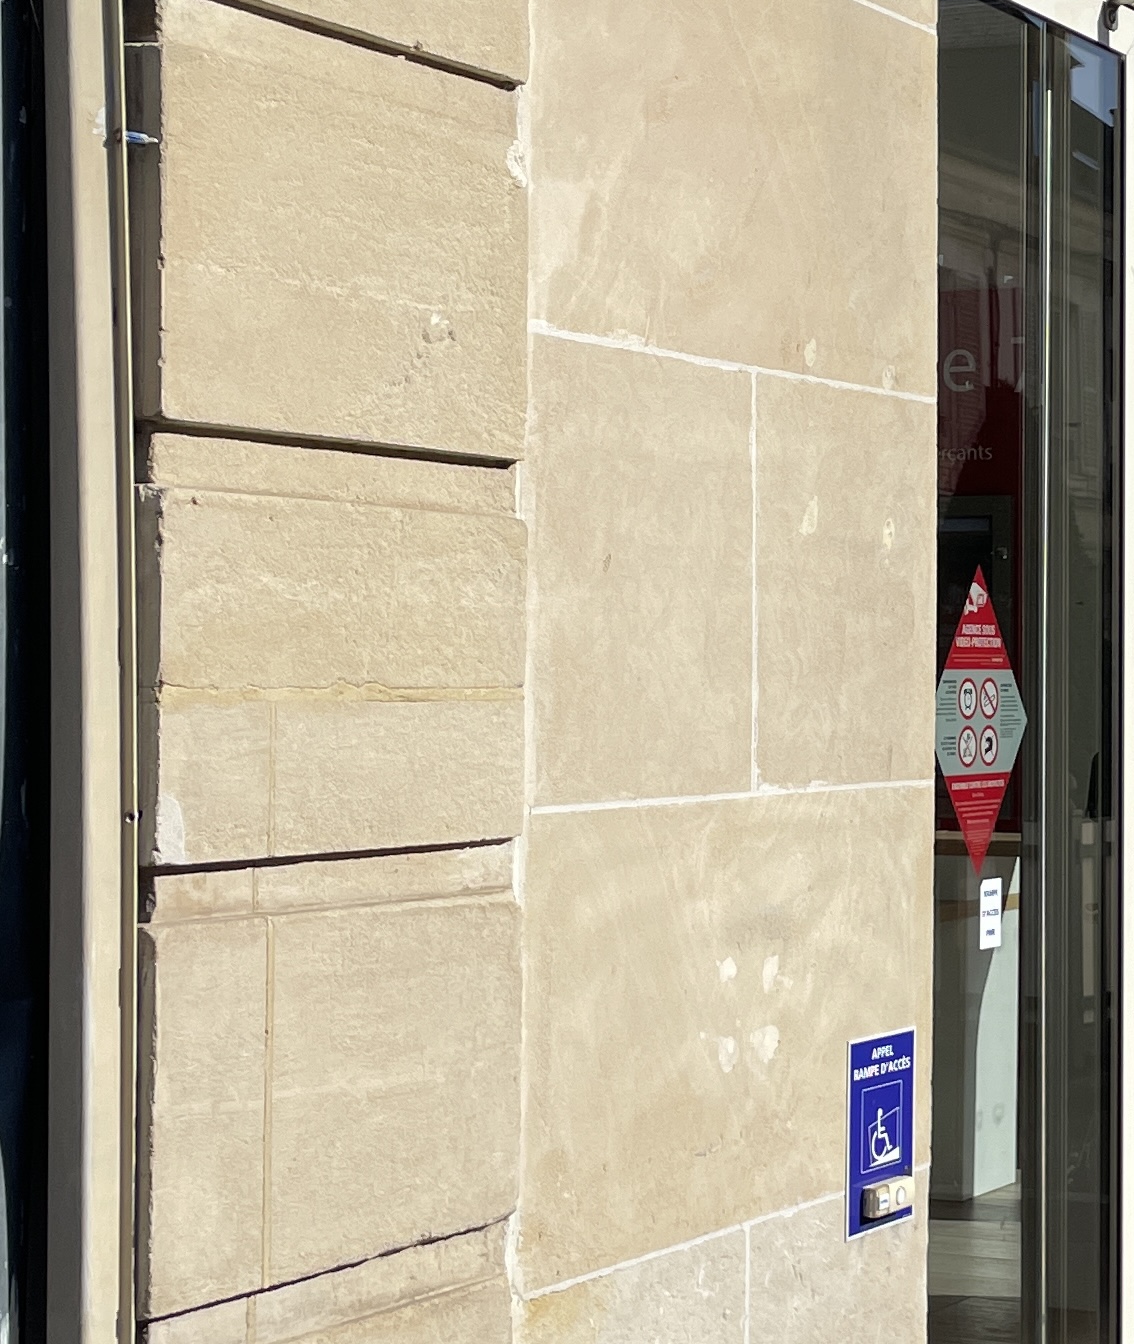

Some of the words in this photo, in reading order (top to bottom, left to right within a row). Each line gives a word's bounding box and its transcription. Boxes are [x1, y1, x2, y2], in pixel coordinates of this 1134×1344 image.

[871, 1045, 894, 1060] APPEL
[853, 1064, 880, 1081] RAMPE
[880, 1055, 911, 1075] D'ACCÈS
